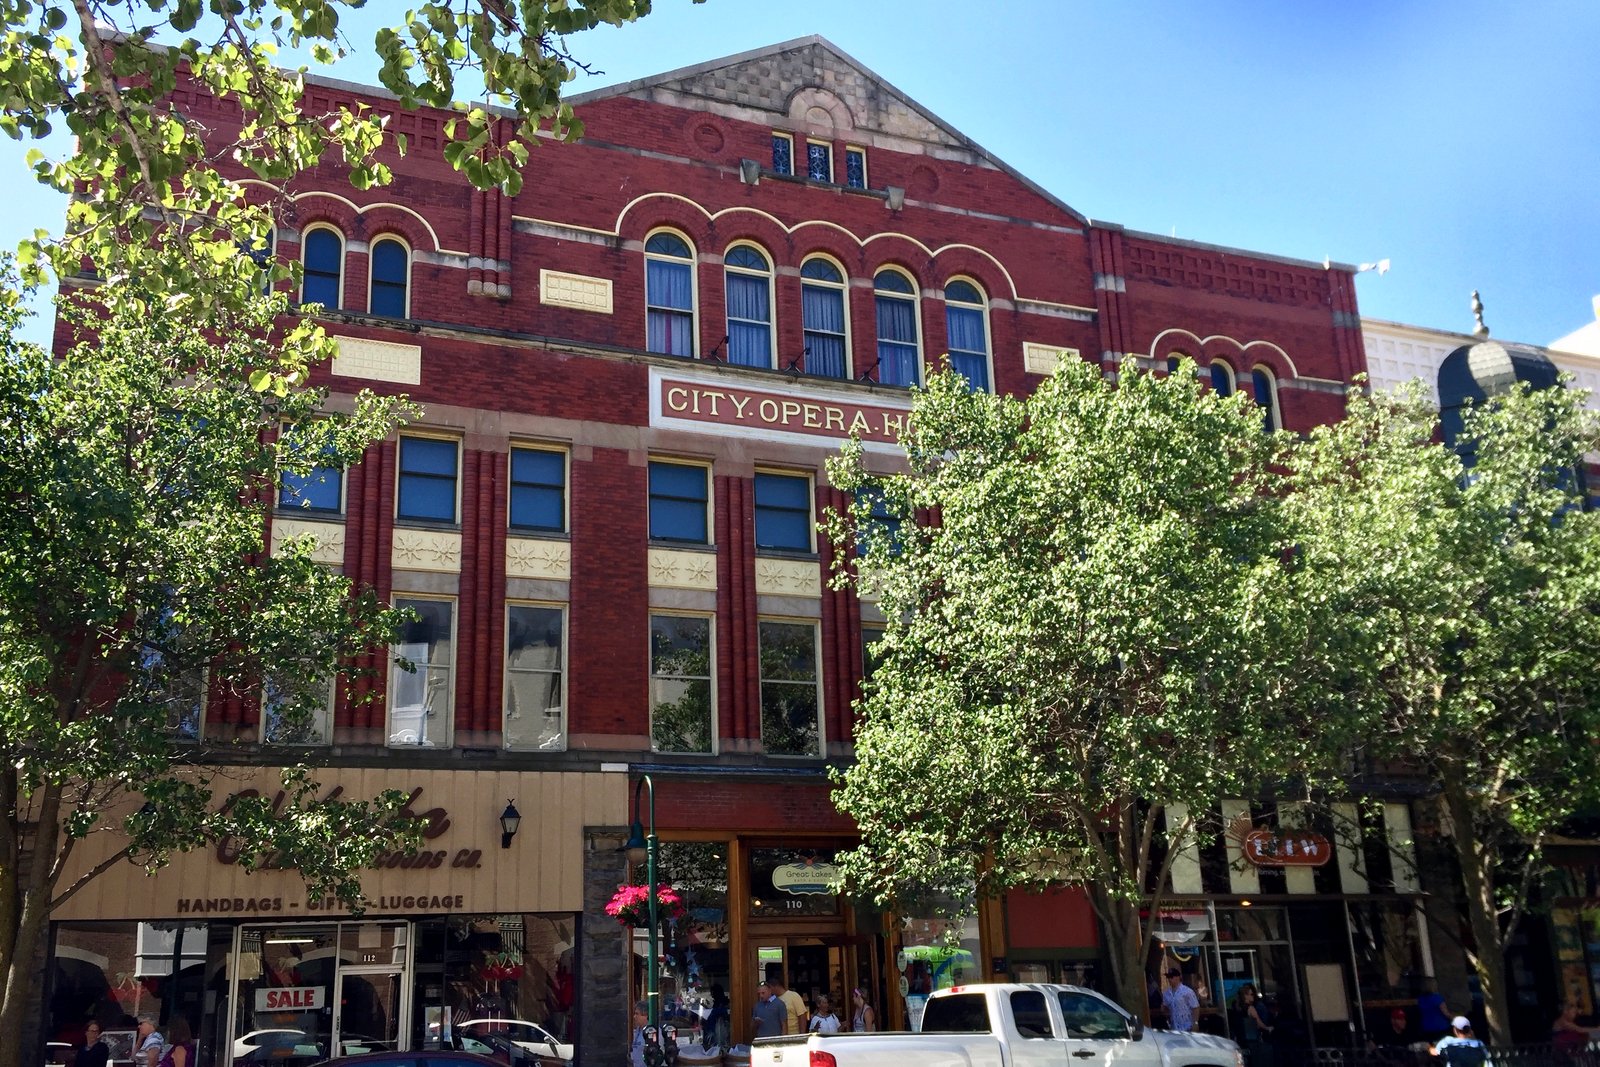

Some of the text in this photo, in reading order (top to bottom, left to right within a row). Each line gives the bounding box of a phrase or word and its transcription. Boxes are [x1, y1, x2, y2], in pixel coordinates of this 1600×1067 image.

[668, 387, 752, 419] CITY
[759, 399, 871, 435] OPERA
[373, 849, 447, 868] GOODS
[452, 849, 482, 868] CO.
[177, 898, 282, 913] HANDBAGS
[380, 895, 464, 910] LUGGAGE
[786, 900, 803, 909] 110
[363, 954, 376, 963] 112
[266, 989, 315, 1009] SALE
